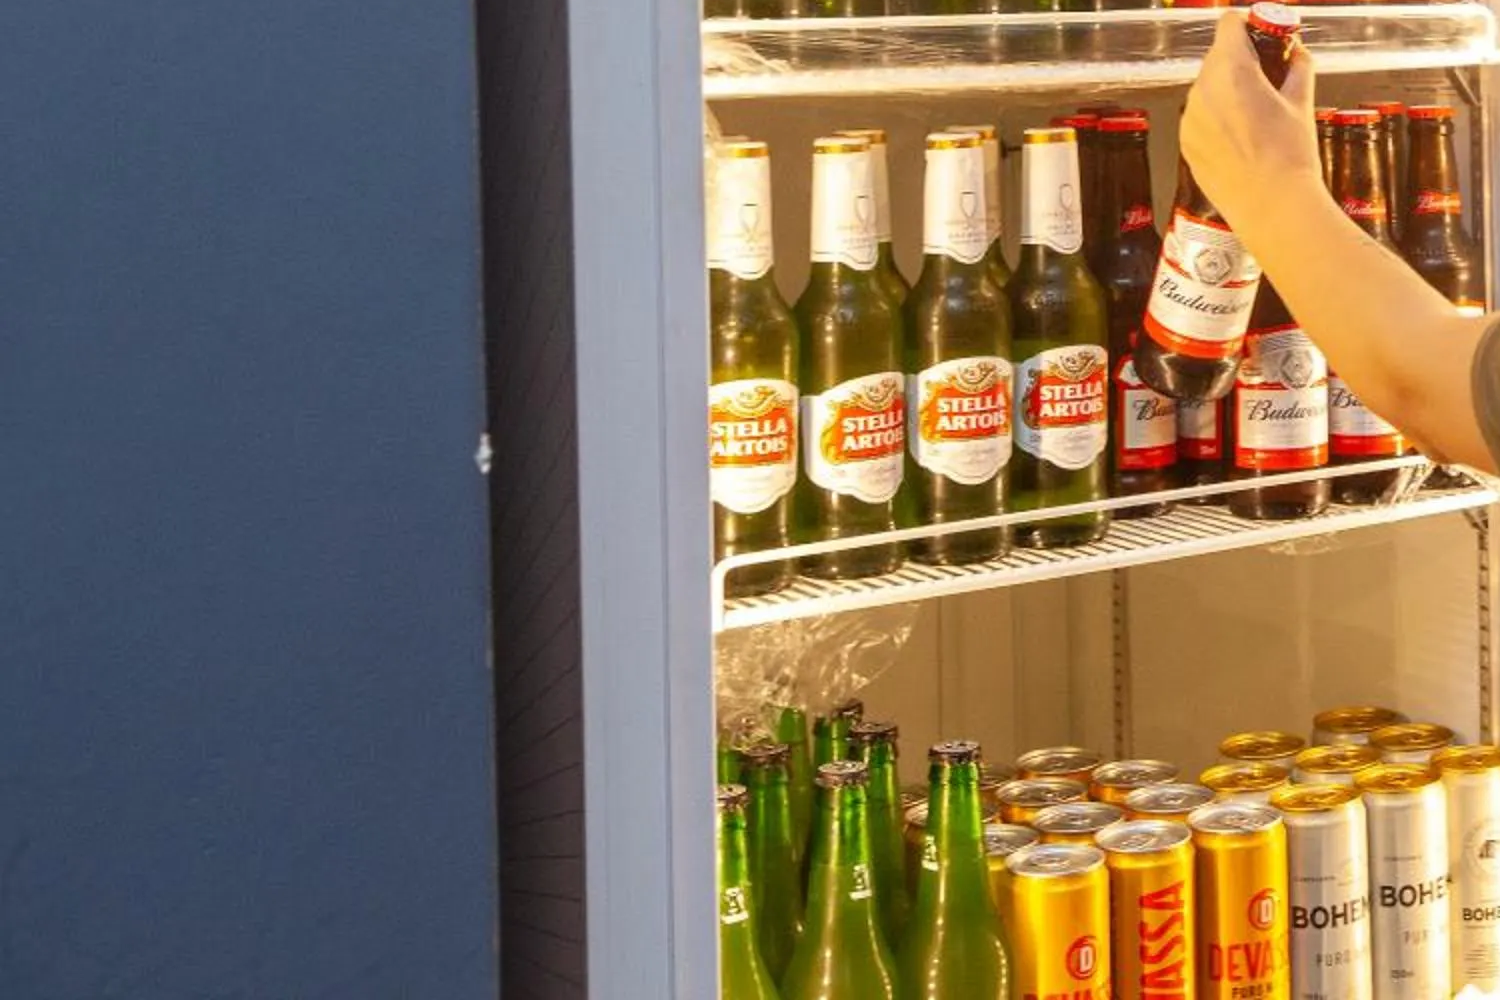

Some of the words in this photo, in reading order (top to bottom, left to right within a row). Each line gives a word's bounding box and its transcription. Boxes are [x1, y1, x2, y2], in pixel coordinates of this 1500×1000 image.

[1158, 272, 1249, 315] Budweiser
[1039, 380, 1104, 401] STELLA
[937, 393, 1006, 413] STELLA
[711, 417, 787, 438] STELLA
[936, 410, 1007, 431] ARTOIS
[711, 435, 788, 456] ARTOIS
